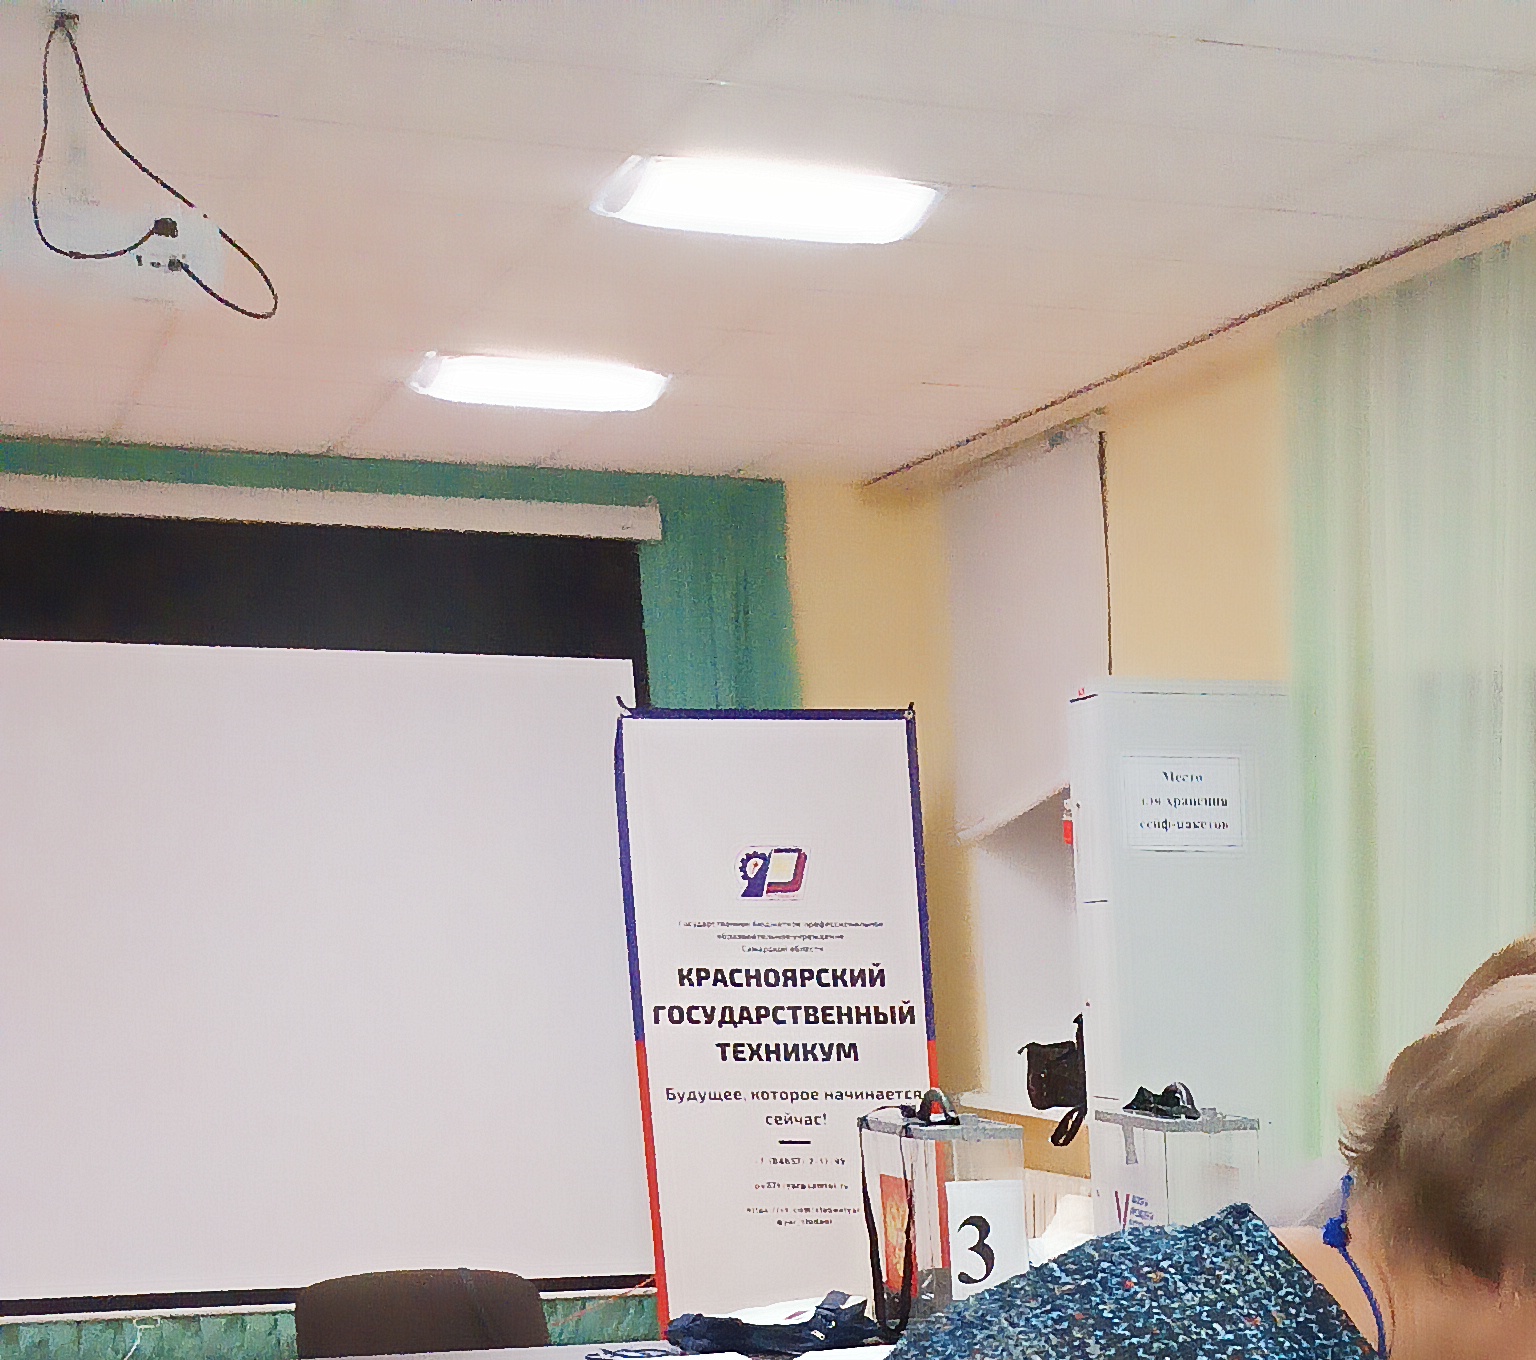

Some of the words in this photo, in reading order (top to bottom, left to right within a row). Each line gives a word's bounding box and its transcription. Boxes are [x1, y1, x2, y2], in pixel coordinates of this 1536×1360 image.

[677, 962, 886, 987] КРАСНОЯРСКИЙ
[652, 1000, 916, 1028] ГОСУДАРСТВЕННЫЙ
[715, 1042, 859, 1062] ТЕХНИКУМ
[665, 1087, 747, 1104] Будущее,
[751, 1090, 819, 1103] которое
[824, 1089, 923, 1101] начинается
[765, 1112, 828, 1126] сейчас!
[957, 1215, 995, 1284] 3
